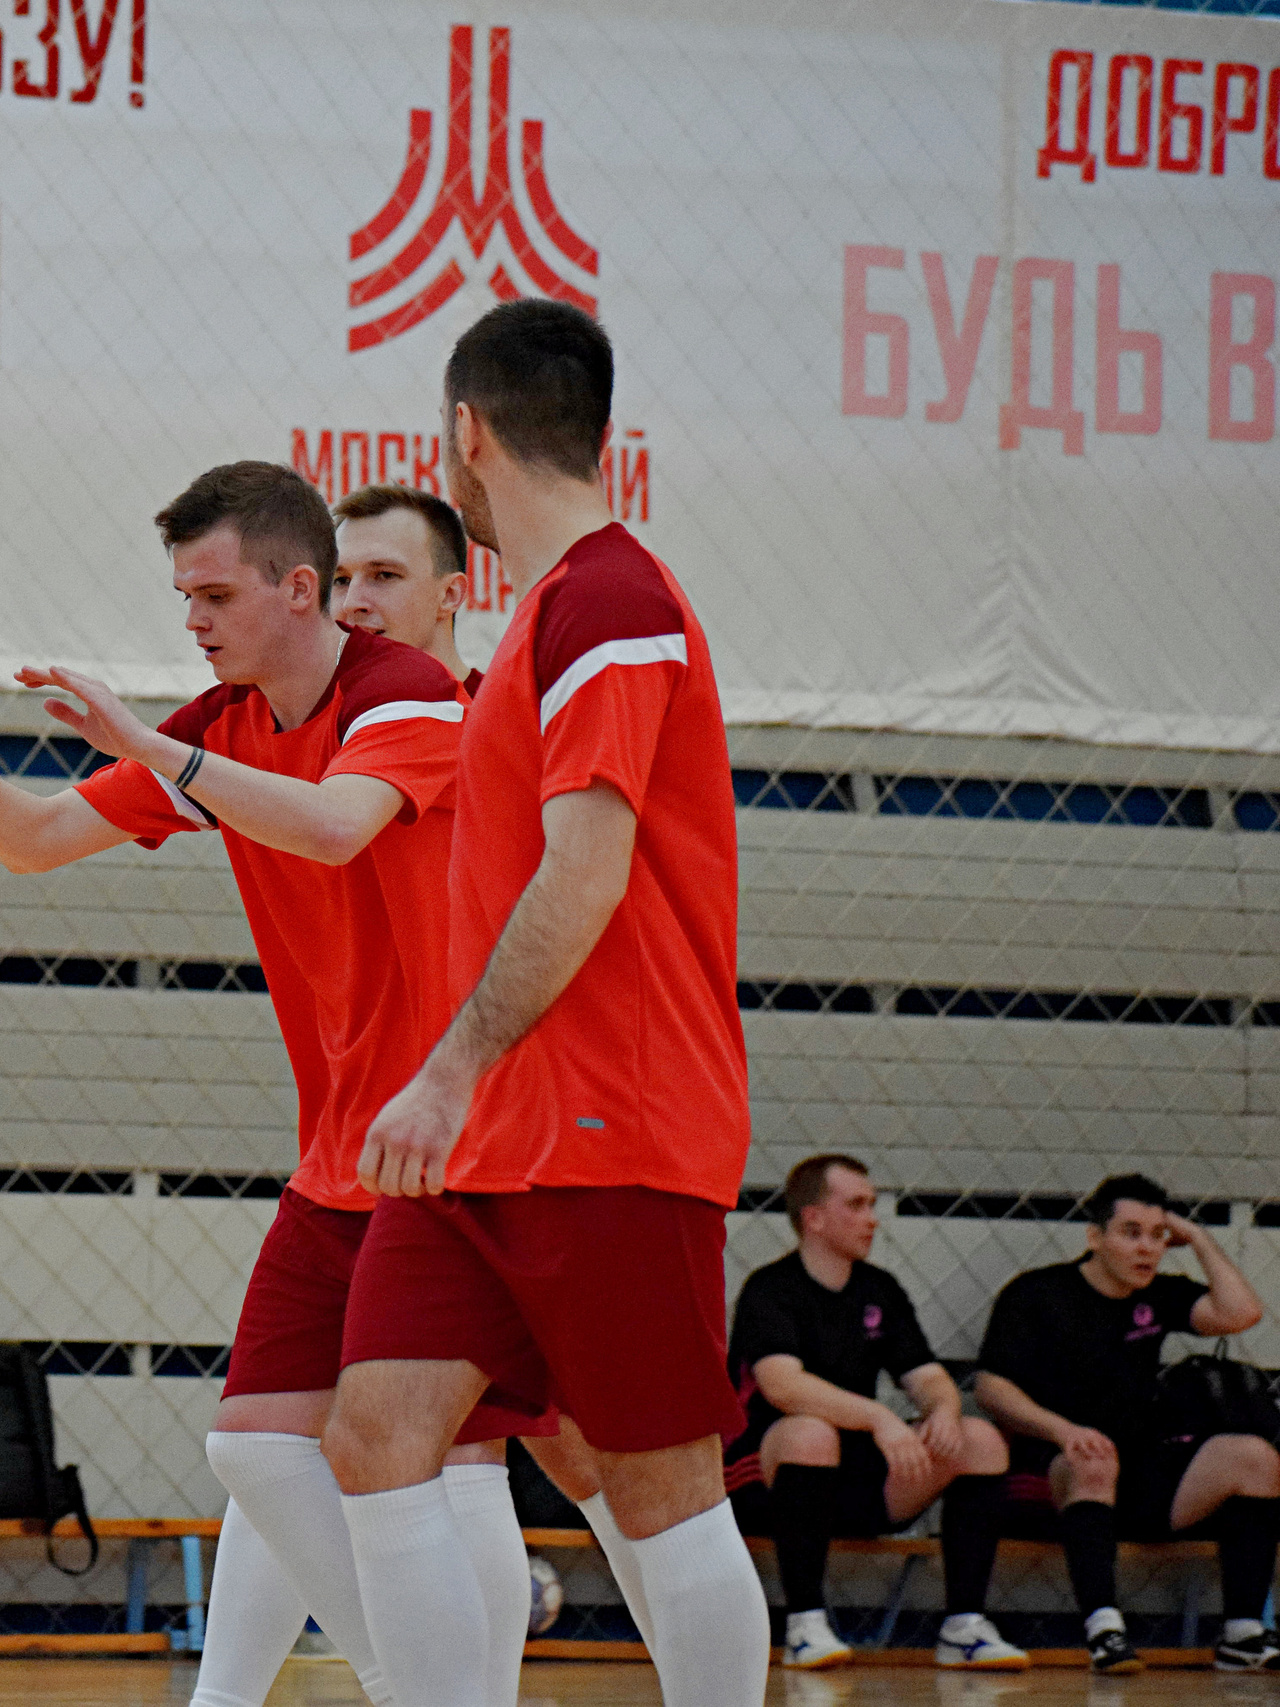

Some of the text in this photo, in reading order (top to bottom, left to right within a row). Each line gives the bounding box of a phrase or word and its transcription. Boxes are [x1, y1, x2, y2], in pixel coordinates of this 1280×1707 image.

[842, 245, 1276, 456] БУДЬ В
[291, 428, 649, 521] МОСКЙ
